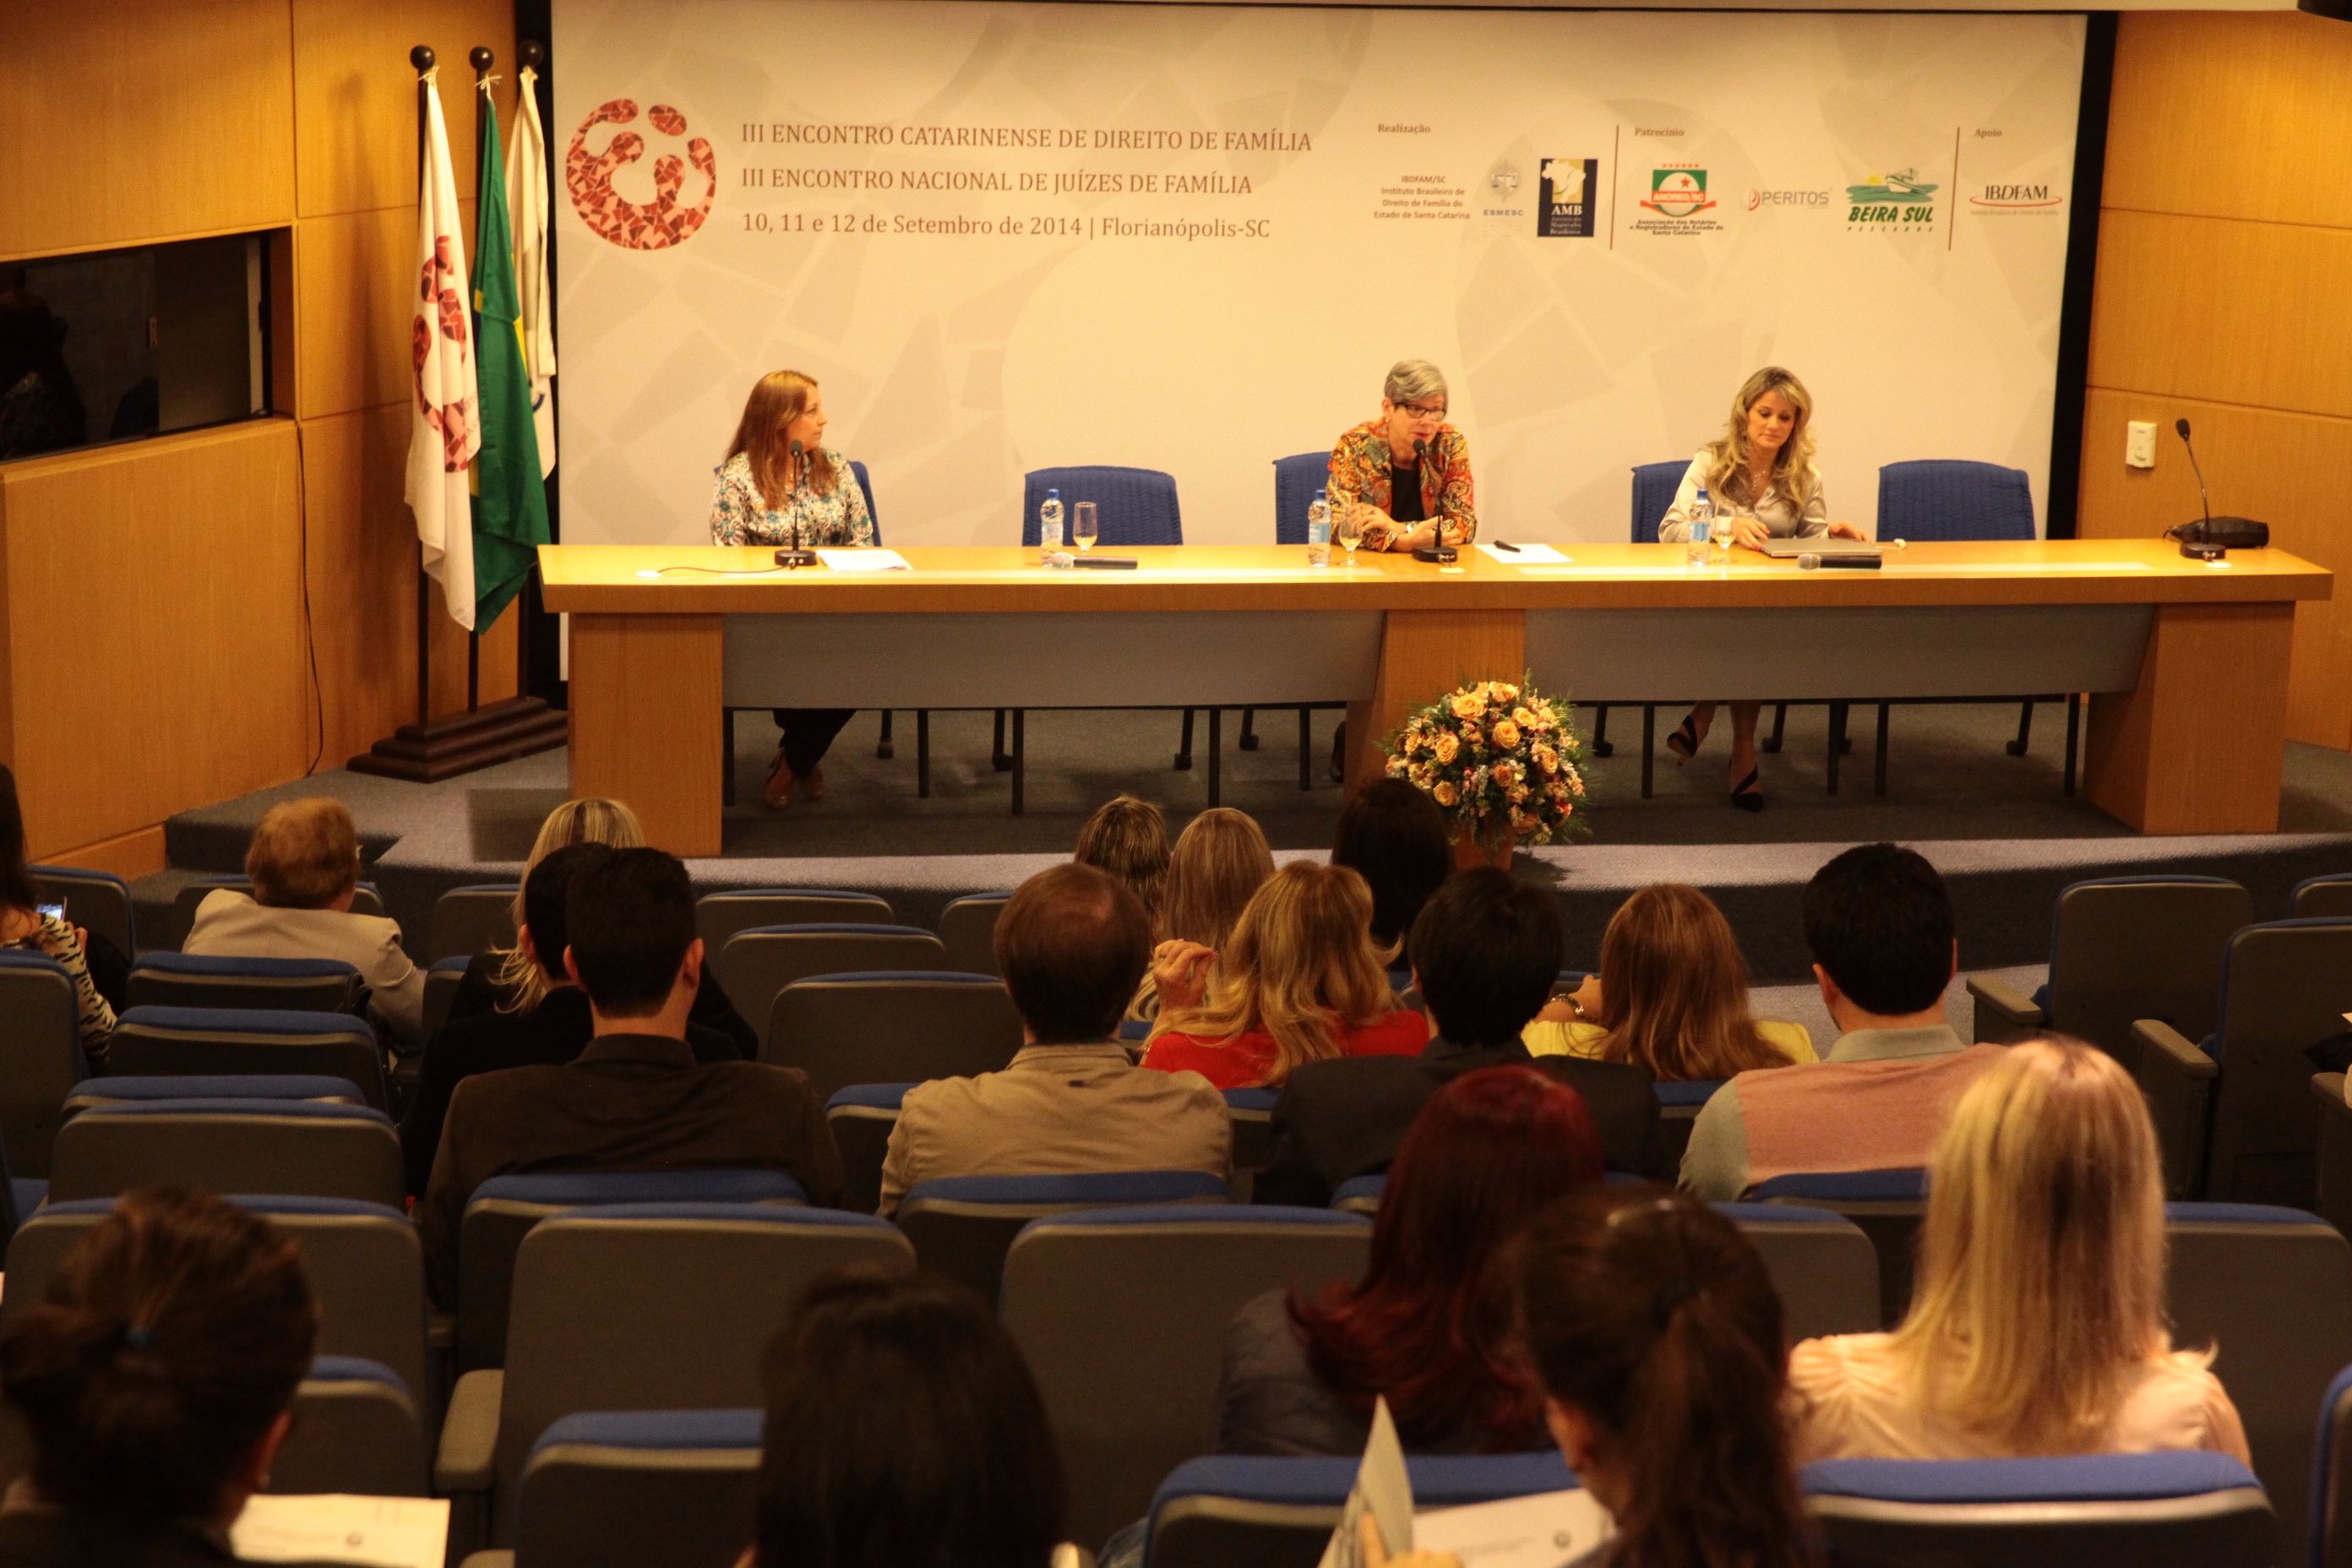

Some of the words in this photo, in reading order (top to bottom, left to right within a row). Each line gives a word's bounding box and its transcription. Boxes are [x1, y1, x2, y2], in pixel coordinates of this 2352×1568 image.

[1378, 124, 1431, 134] Realização
[1635, 128, 1685, 138] Patrocínio
[1974, 128, 2002, 139] Apoio
[742, 123, 764, 144] III
[772, 123, 894, 145] ENCONTRO
[900, 126, 1052, 148] CATARINENSE
[1059, 129, 1087, 149] DE
[1094, 129, 1183, 150] DIREITO
[1190, 131, 1218, 150] DE
[1224, 127, 1312, 152] FAMÍLIA
[742, 167, 764, 188] III
[772, 168, 894, 189] ENCONTRO
[901, 171, 1013, 191] NACIONAL
[1019, 172, 1048, 192] DE
[1054, 167, 1123, 194] JUÍZES
[1130, 174, 1158, 193] DE
[1164, 169, 1252, 194] FAMÍLIA
[1652, 193, 1690, 201] ANOREG
[1761, 191, 1830, 204] PERITOS
[1984, 185, 2048, 199] IBDFAM
[1437, 211, 1471, 220] Catarina
[1551, 204, 1582, 215] AMB
[1848, 207, 1897, 222] BEIRA
[1903, 206, 1933, 222] SUL
[744, 213, 773, 234] 10,
[781, 213, 803, 232] 11
[812, 218, 824, 232] e
[832, 213, 856, 233] 12
[862, 213, 887, 233] de
[893, 214, 993, 234] Setembro
[999, 215, 1024, 235] de
[1030, 216, 1082, 236] 2014
[1102, 217, 1270, 242] Florianópolis-SC
